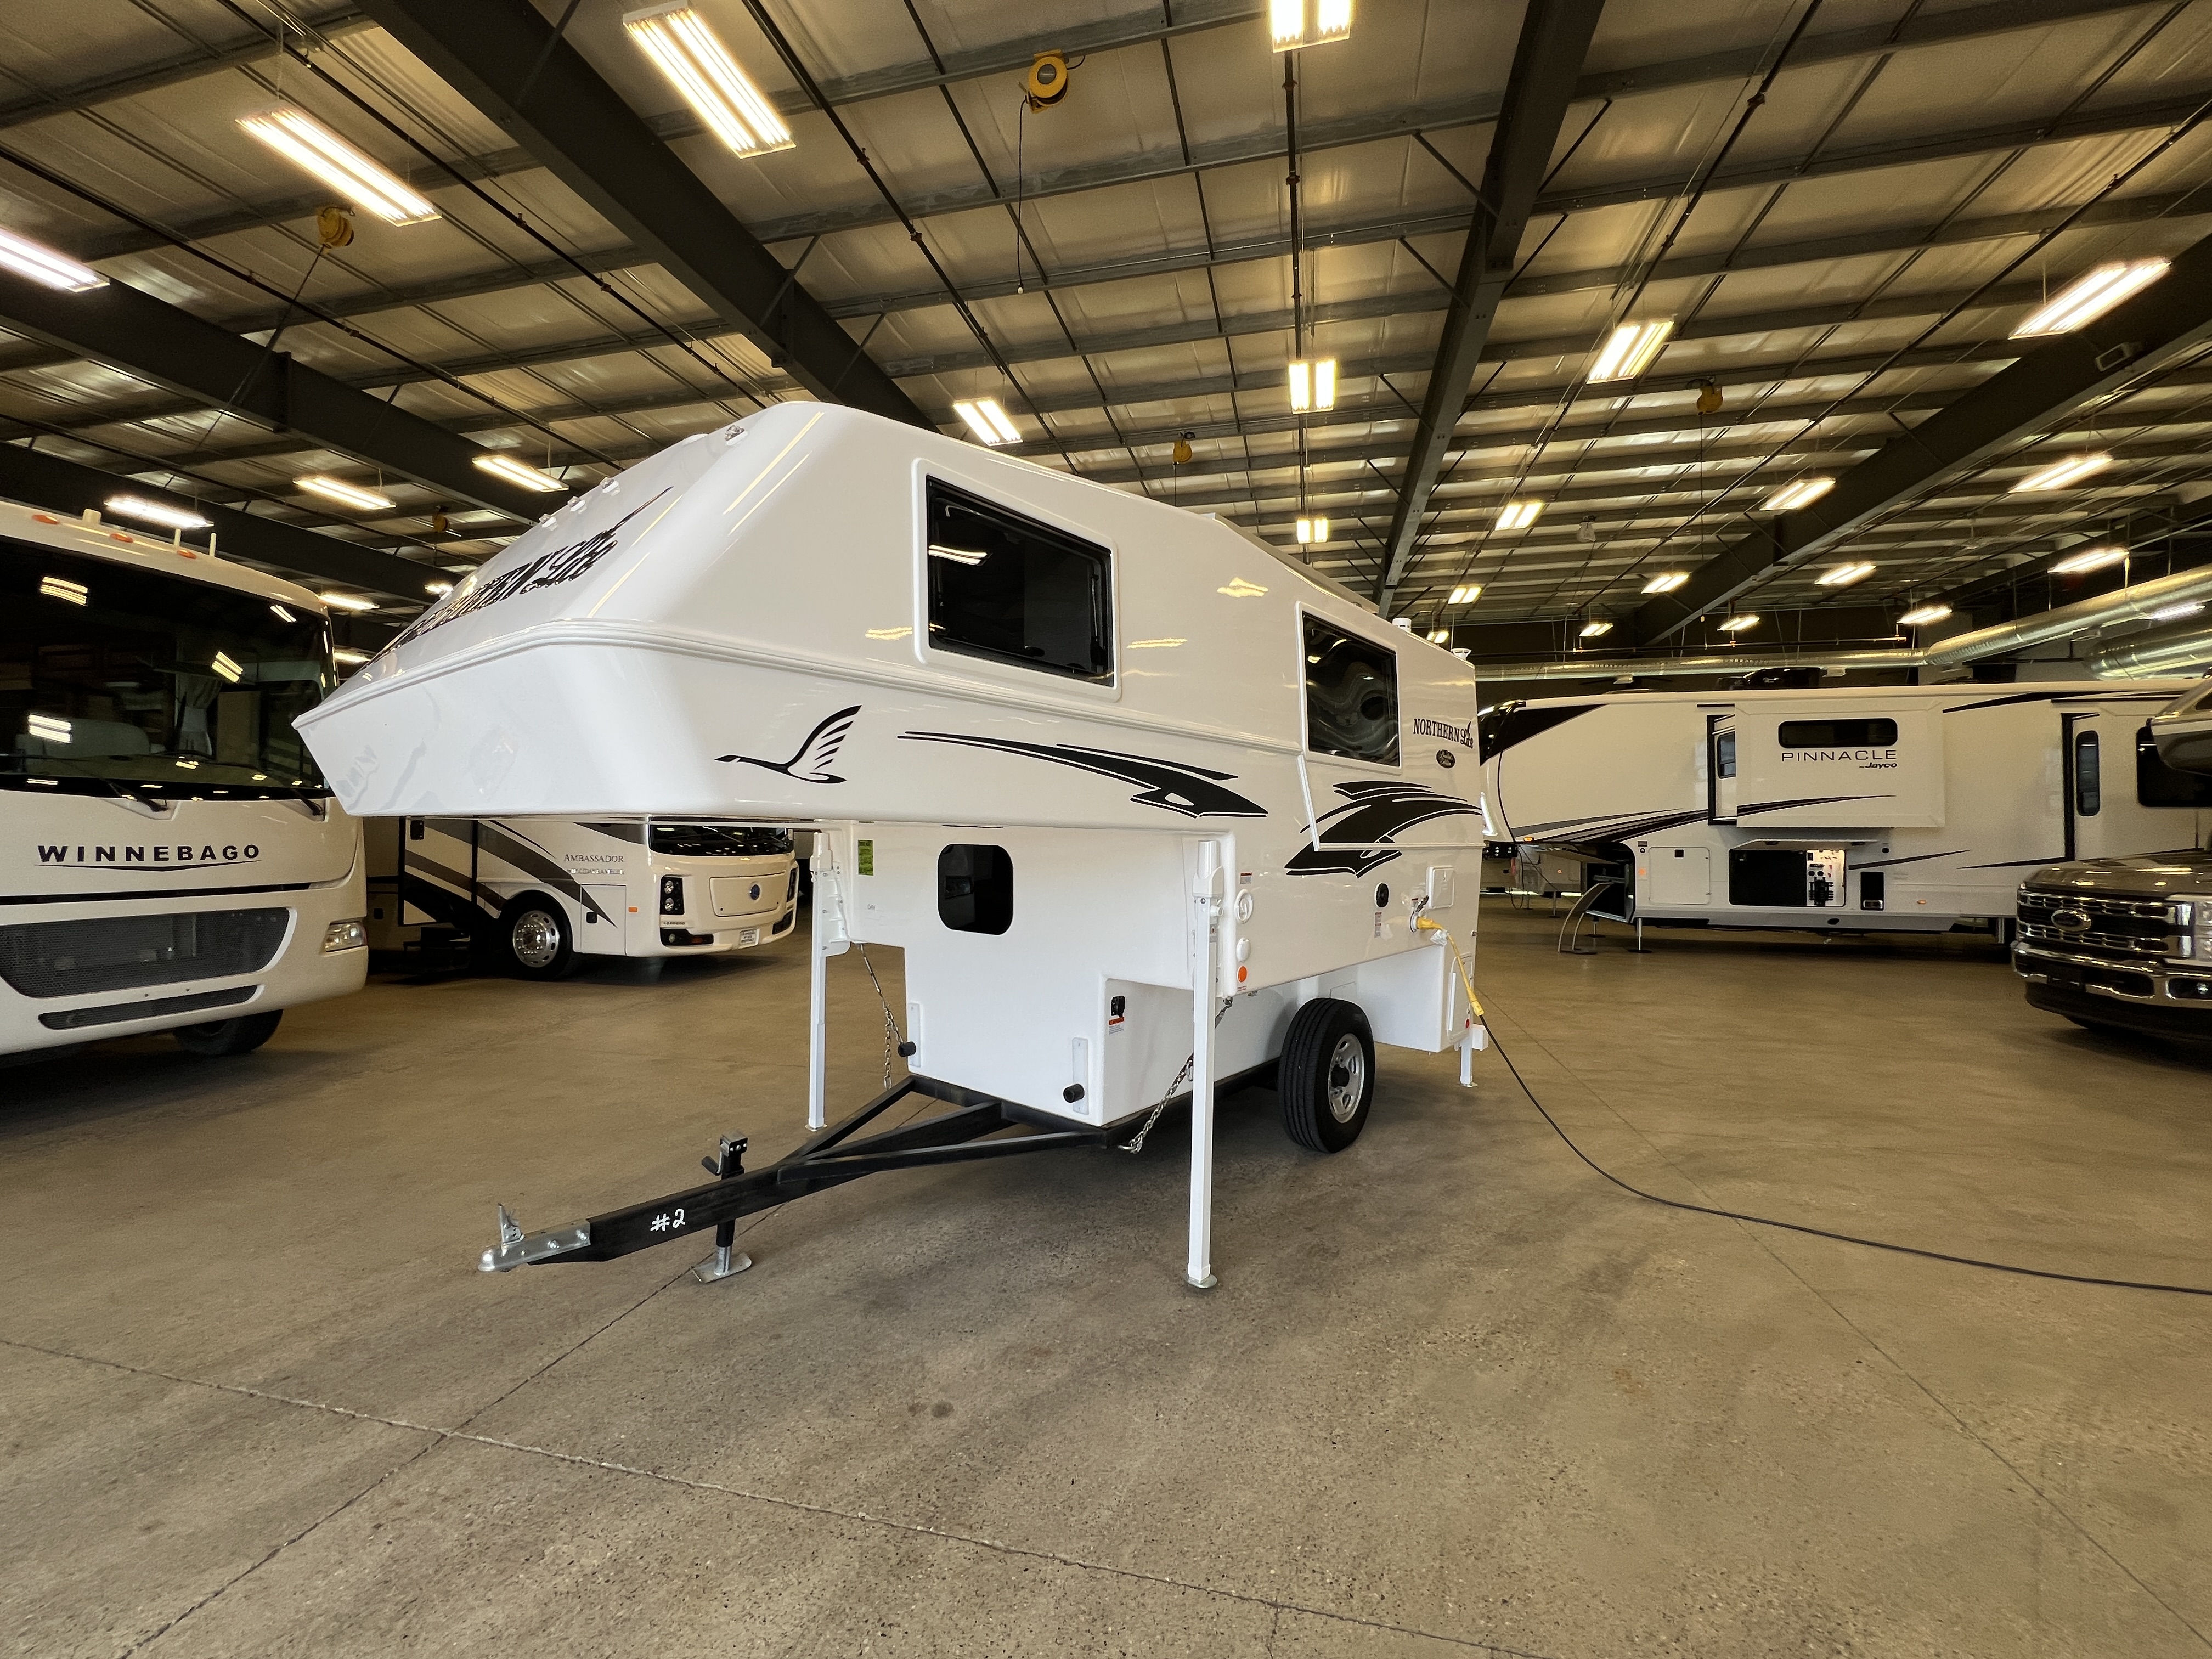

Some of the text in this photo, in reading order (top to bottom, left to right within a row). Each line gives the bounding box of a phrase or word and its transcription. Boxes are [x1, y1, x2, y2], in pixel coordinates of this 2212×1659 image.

[1413, 718, 1460, 742] NORTHERN
[1782, 749, 1897, 761] PINNACLE
[38, 844, 259, 862] WINNEBAGO
[563, 854, 624, 862] AMBASSADOR
[650, 1208, 686, 1232] #2
